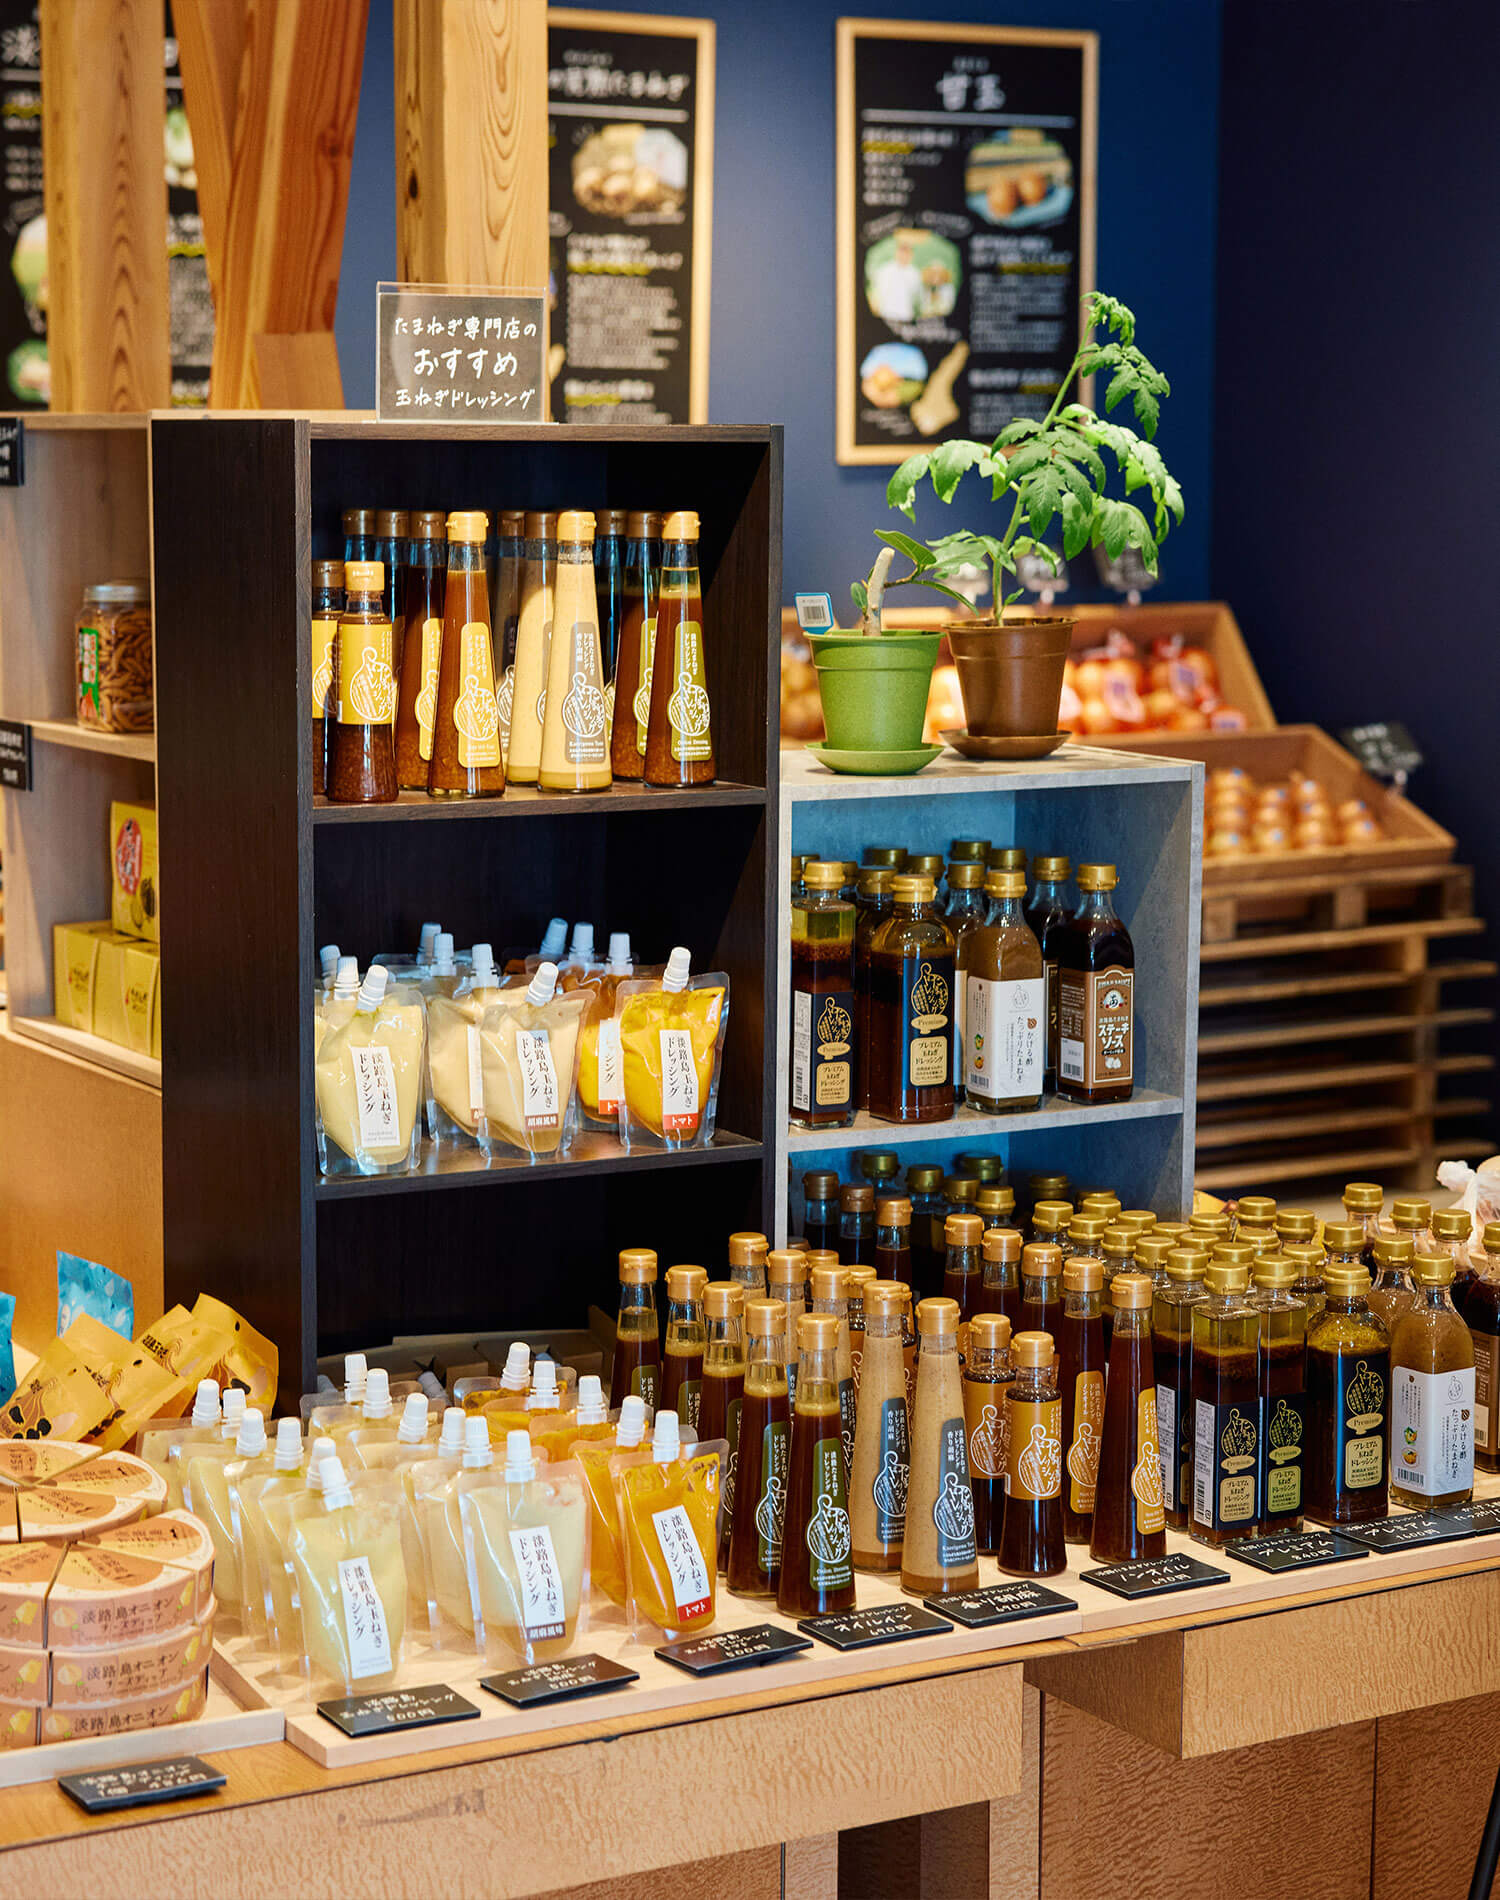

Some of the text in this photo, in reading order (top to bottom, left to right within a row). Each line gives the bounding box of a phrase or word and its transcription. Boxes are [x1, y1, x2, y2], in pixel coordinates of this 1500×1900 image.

[395, 316, 537, 340] たまねぎ専門店の
[414, 347, 517, 379] おすすめ
[396, 387, 536, 409] 玉ねぎドレッシング
[1097, 1022, 1130, 1037] ステーキ
[1101, 1034, 1125, 1050] ソース
[522, 1038, 539, 1098] ドレッシング
[667, 1037, 681, 1098] ドレッシング
[359, 1053, 377, 1115] ドレッシング
[671, 1115, 693, 1128] トマト
[1353, 1441, 1379, 1450] プレミアム
[1351, 1456, 1380, 1467] ドレッシング
[1364, 1519, 1439, 1537] プレミアム
[1395, 1528, 1441, 1541] 1600円
[660, 1519, 687, 1586] ドレッシング
[671, 1514, 703, 1593] 淡路島玉ねぎ
[1258, 1540, 1335, 1557] プレミアム
[519, 1537, 541, 1609] ドレッシング
[532, 1535, 558, 1616] 淡路島玉ねぎ
[1119, 1563, 1191, 1583] ノンオイル
[1151, 1573, 1192, 1585] 690円
[343, 1567, 366, 1642] ドレッシング
[684, 1601, 706, 1618] トマト
[960, 1590, 1042, 1611] 香り胡麻
[995, 1601, 1038, 1613] 690円
[81, 1598, 176, 1625] 淡路島オニオン
[833, 1614, 913, 1633] オイルイン
[869, 1623, 913, 1636] 690円
[725, 1643, 771, 1658] 500円
[87, 1652, 180, 1679] 淡路島オニオン
[73, 1705, 170, 1733] 淡路島オニオン
[386, 1708, 436, 1722] 500円
